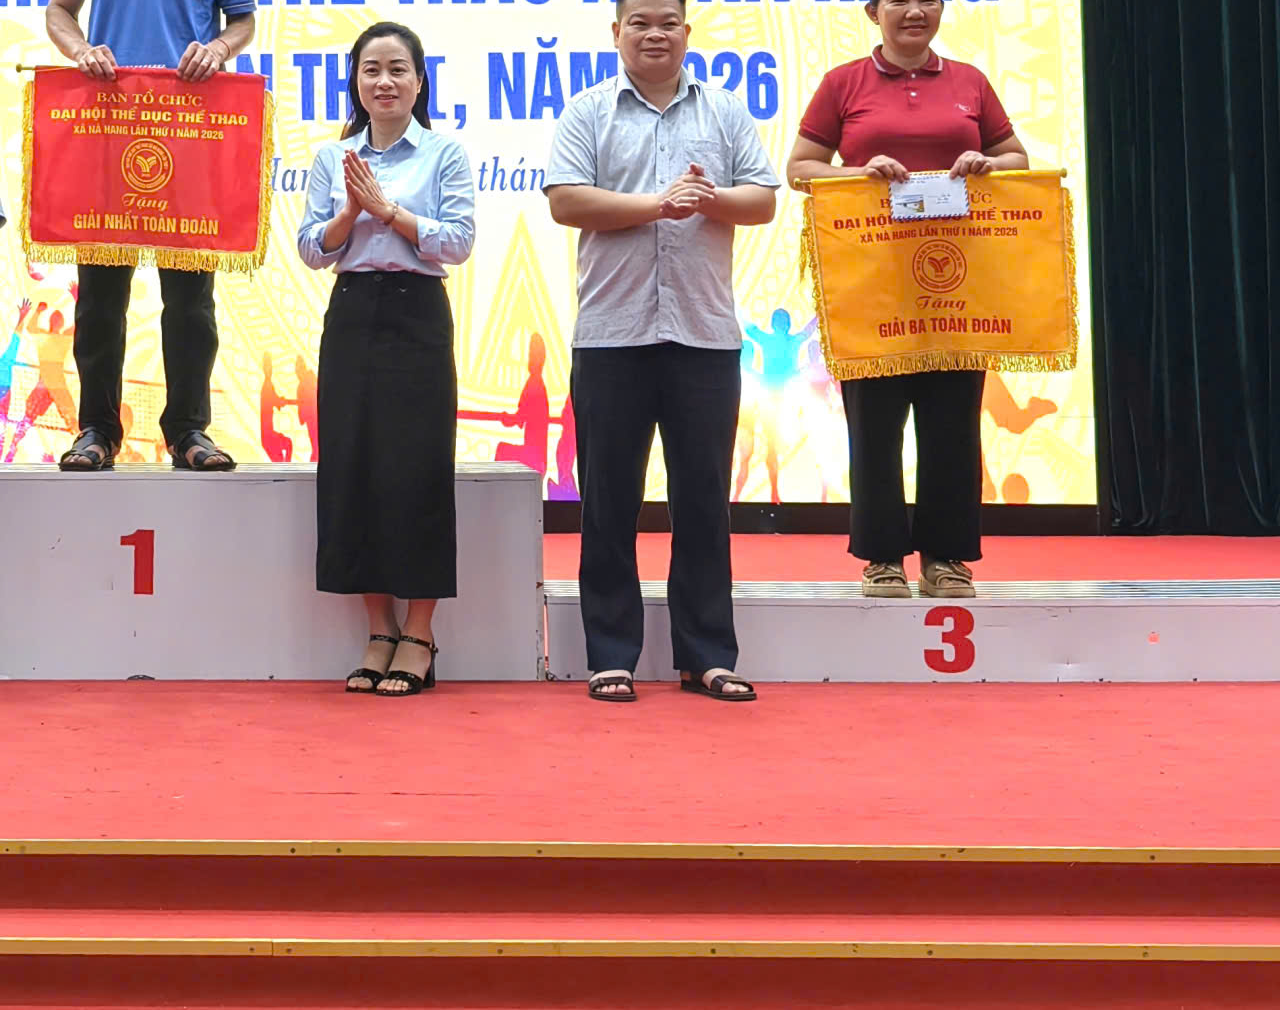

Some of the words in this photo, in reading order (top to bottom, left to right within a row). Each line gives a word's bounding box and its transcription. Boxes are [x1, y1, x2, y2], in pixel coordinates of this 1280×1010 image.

[293, 53, 353, 121] TH
[97, 93, 128, 102] BAN
[132, 89, 154, 104] TỔ
[160, 93, 203, 107] CHỨC
[51, 109, 76, 121] ĐẠI
[81, 107, 105, 120] HỘI
[112, 106, 138, 120] THỂ
[141, 110, 171, 124] DỤC
[177, 110, 205, 123] THỂ
[209, 113, 248, 125] THAO
[104, 125, 128, 135] HANG
[201, 130, 224, 139] 2026
[479, 157, 545, 192] thán
[123, 193, 168, 211] Tặng
[971, 191, 992, 204] ỨC
[74, 209, 100, 229] GIẢI
[105, 210, 138, 231] NHẤT
[142, 214, 176, 233] TOÀN
[180, 215, 218, 235] ĐOÀN
[834, 218, 860, 231] ĐẠI
[866, 213, 892, 227] HỘI
[1001, 210, 1043, 220] THAO
[892, 228, 916, 240] HANG
[916, 296, 966, 310] Tặng
[879, 317, 905, 338] GIẢI
[910, 318, 926, 334] BA
[930, 315, 967, 333] TOÀN
[972, 316, 1011, 334] ĐOÀN
[120, 529, 155, 596] 1
[924, 606, 976, 674] 3
